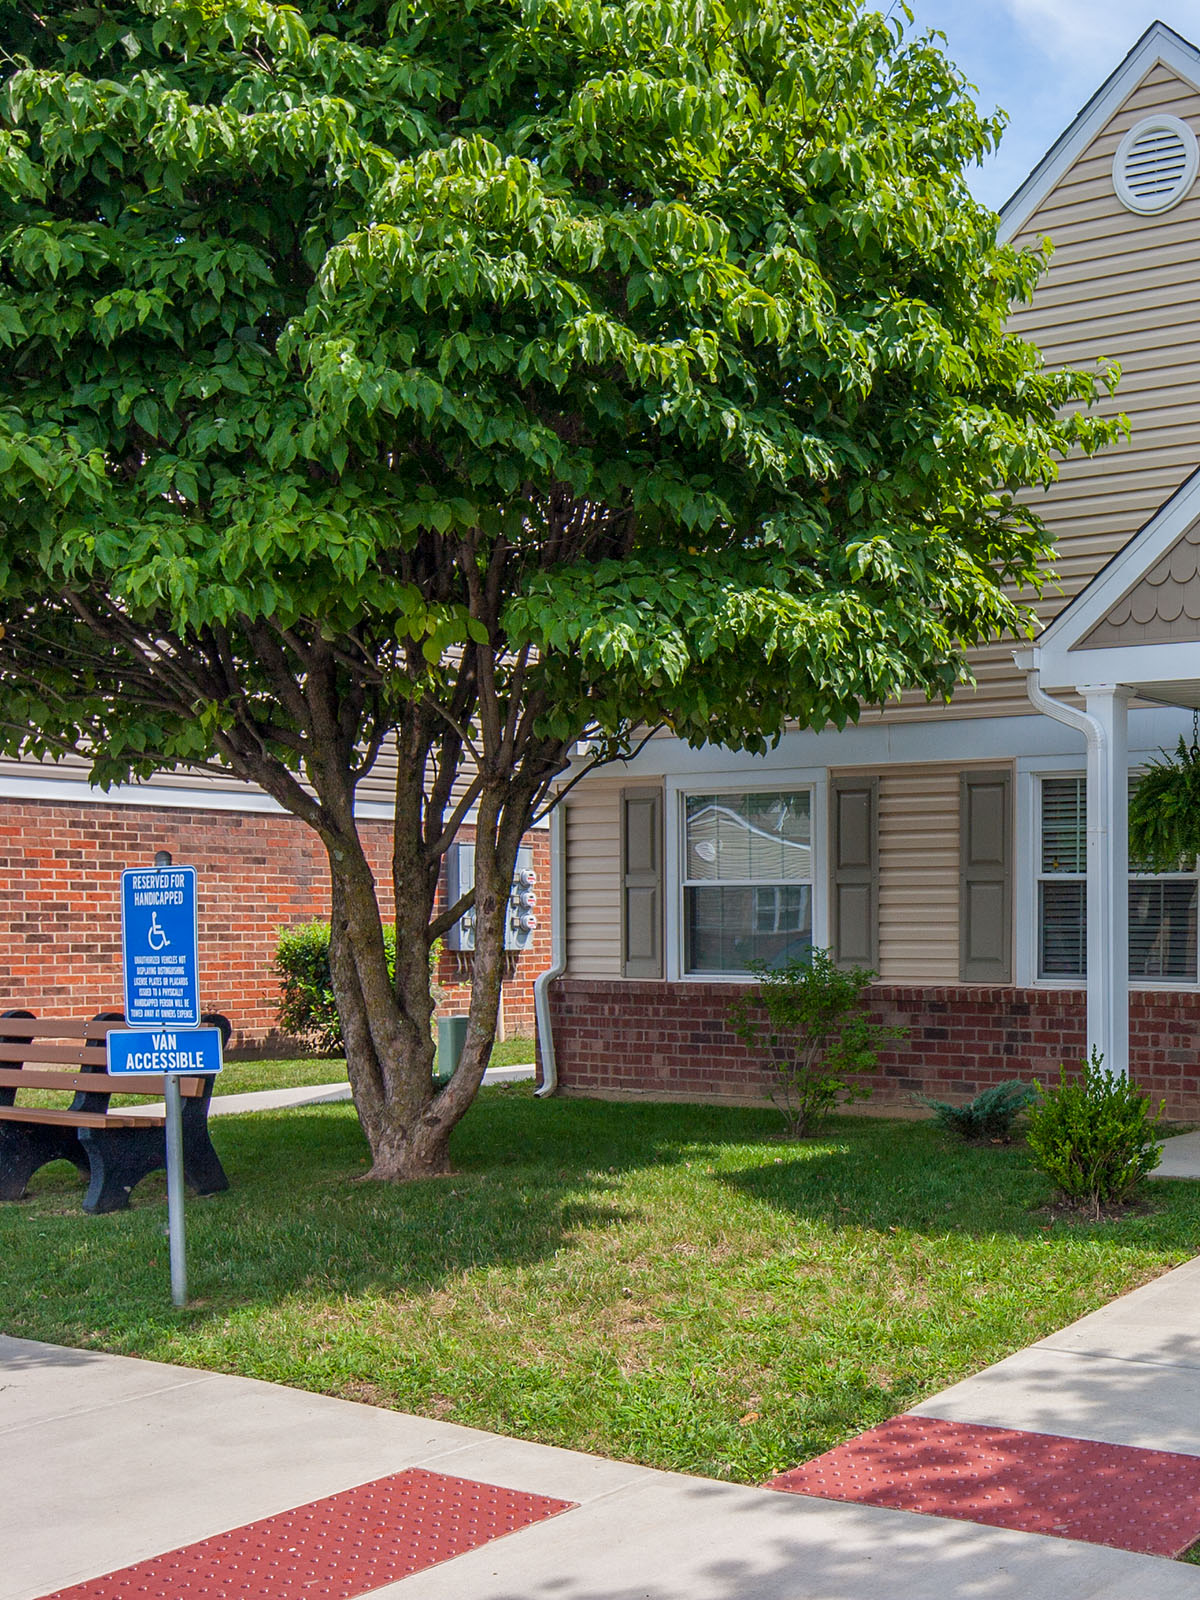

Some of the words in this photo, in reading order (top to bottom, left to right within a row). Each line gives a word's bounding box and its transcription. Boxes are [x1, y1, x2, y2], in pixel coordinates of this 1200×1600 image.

[132, 874, 170, 890] RESERVED
[171, 874, 185, 889] FOR
[134, 891, 184, 906] HANDICAPPED
[151, 1034, 177, 1051] VAN
[126, 1052, 204, 1070] ACCESSIBLE
